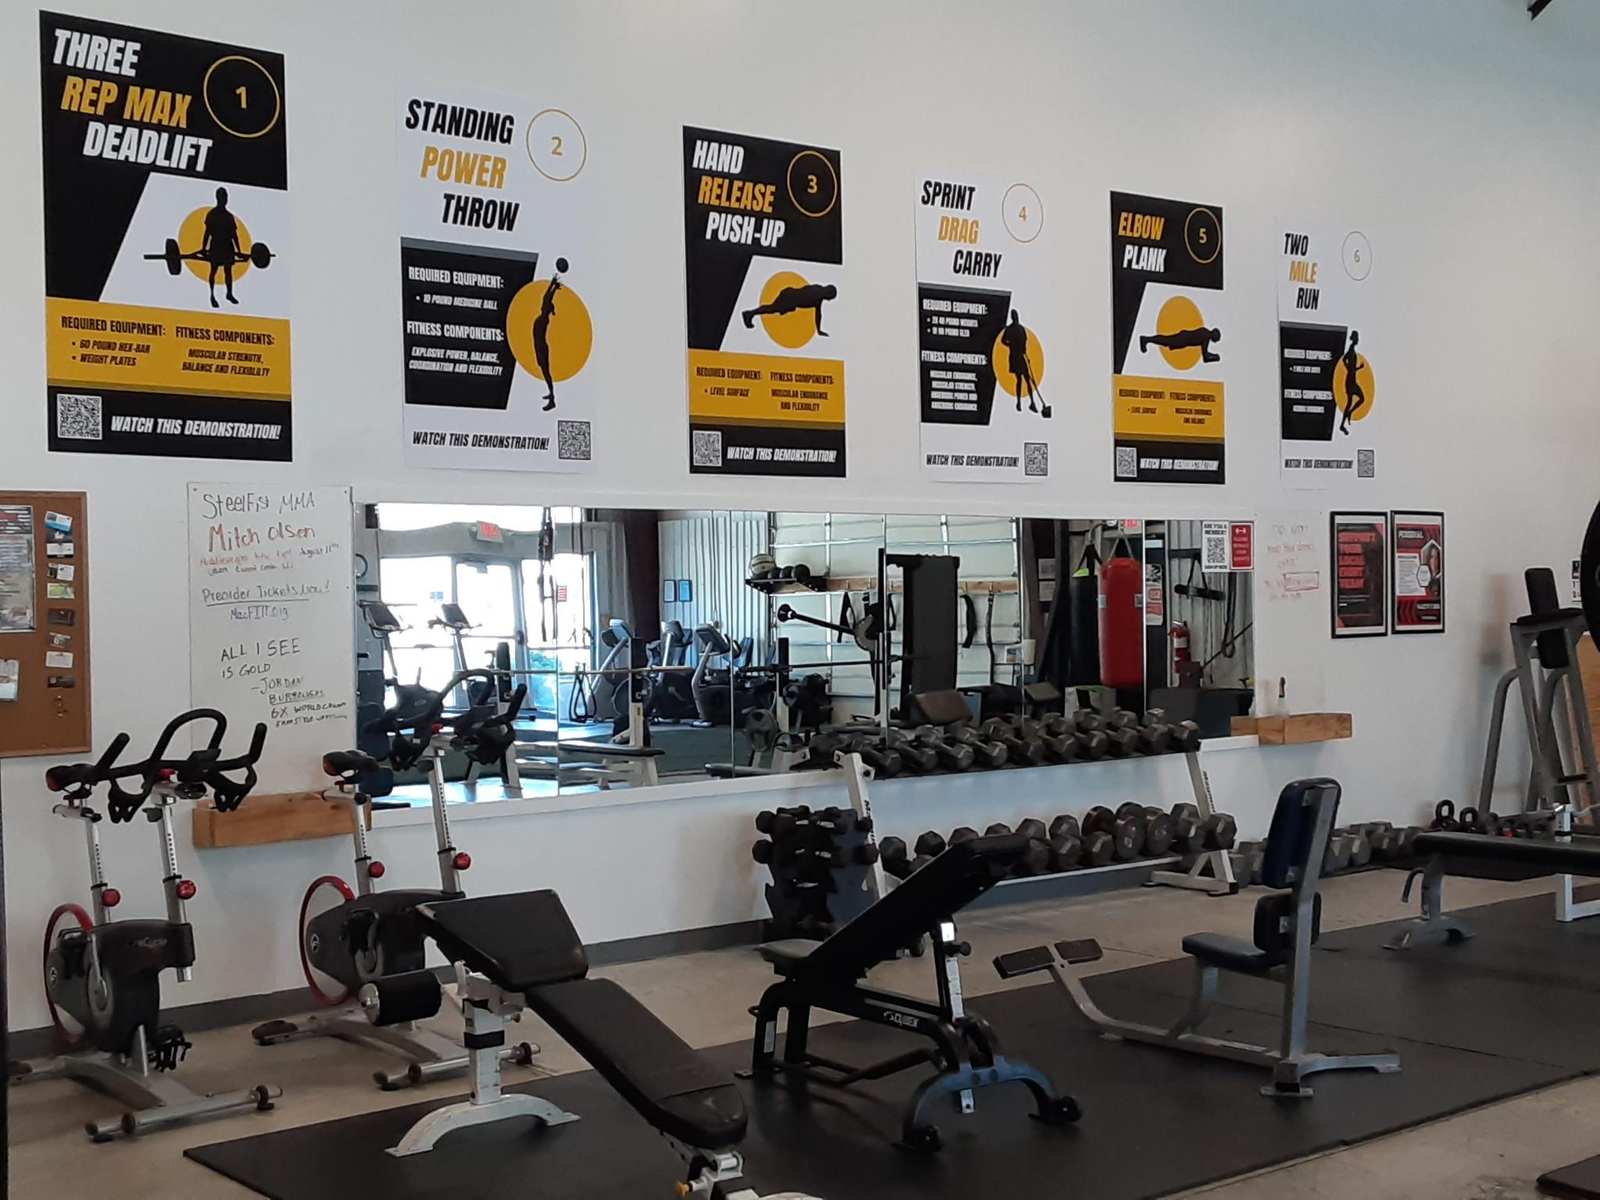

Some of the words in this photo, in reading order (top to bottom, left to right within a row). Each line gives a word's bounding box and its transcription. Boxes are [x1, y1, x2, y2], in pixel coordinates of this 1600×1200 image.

[53, 28, 141, 77] THREE
[60, 75, 118, 116] REP
[123, 86, 192, 129] MAX
[235, 86, 247, 109] 1
[405, 99, 514, 144] STANDING
[82, 121, 213, 172] DEADLIFT
[551, 136, 563, 156] 2
[692, 139, 745, 174] HAND
[420, 146, 507, 189] POWER
[698, 175, 776, 213] RELEASE
[807, 175, 818, 194] 3
[921, 180, 976, 211] SPRINT
[442, 193, 520, 232] THROW
[1018, 206, 1027, 221] 4
[705, 211, 786, 248] PUSH-UP
[938, 215, 979, 244] DRAG
[1118, 211, 1165, 241] ELBOW
[1199, 227, 1207, 244] 5
[1284, 233, 1309, 256] TWO
[1353, 249, 1361, 263] 6
[953, 249, 1002, 278] CARRY
[1122, 244, 1167, 273] PLANK
[408, 266, 450, 283] REQUIRED
[453, 271, 504, 289] EQUIPMENT:
[1289, 260, 1318, 283] MILE
[1296, 287, 1320, 310] RUN
[61, 315, 107, 331] REQUIRED
[110, 320, 166, 336] EQUIPMENT:
[175, 326, 210, 341] FITNESS
[213, 330, 275, 346] COMPONENTS:
[407, 320, 442, 337] FITNESS
[444, 324, 504, 341] COMPONENTS:
[109, 355, 137, 367] PLATES
[111, 415, 153, 433] WATCH
[157, 418, 182, 434] THIS
[184, 419, 282, 440] DEMONSTRATION!
[412, 431, 447, 447] WATCH
[449, 432, 469, 447] THIS
[471, 433, 550, 450] DEMONSTRATION!
[726, 446, 755, 460] WATCH
[755, 447, 773, 461] THIS
[220, 643, 247, 662] ALL
[267, 637, 301, 657] SEE
[239, 663, 271, 676] GOLD
